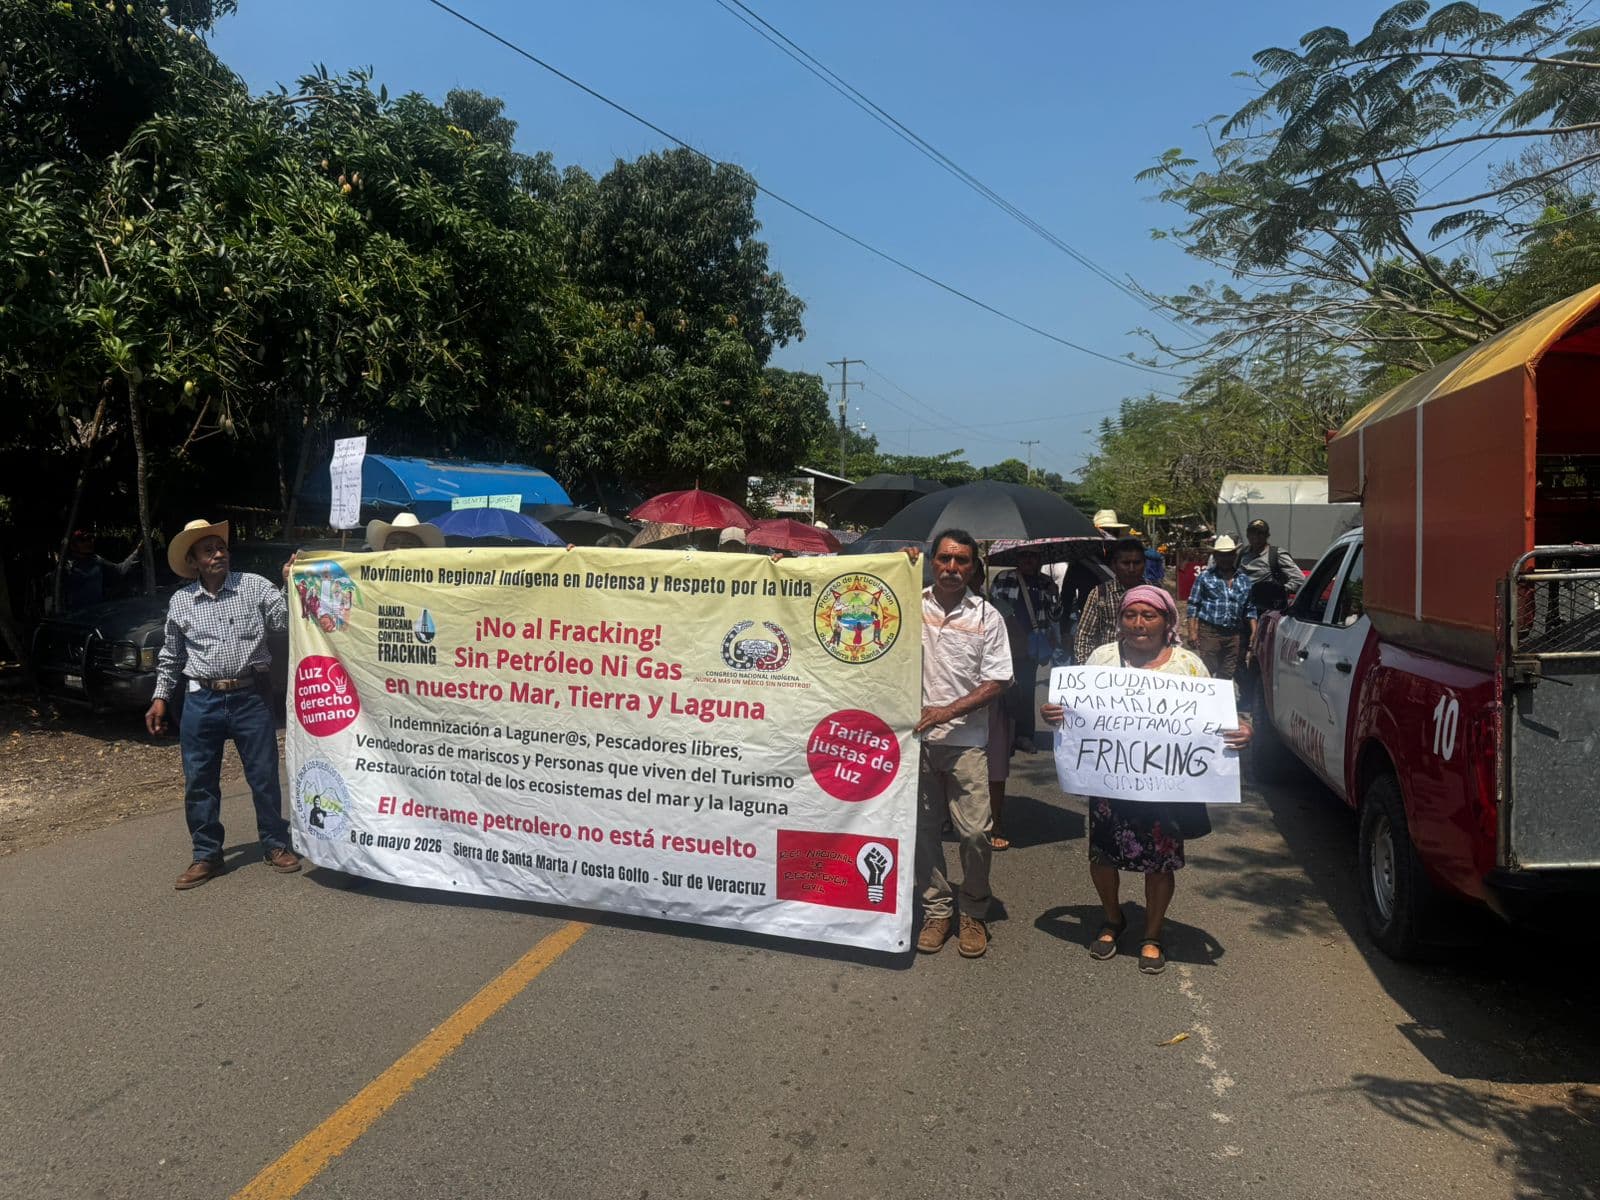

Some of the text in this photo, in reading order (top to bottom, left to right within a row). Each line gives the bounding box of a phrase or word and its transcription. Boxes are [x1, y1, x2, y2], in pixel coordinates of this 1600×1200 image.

[360, 565, 812, 598] Movimiento Regional Indígena en Defensa y Respeto por la Vida
[842, 576, 852, 584] de
[378, 604, 406, 618] ALIANZA
[378, 618, 412, 631] MEXICANA
[476, 616, 662, 650] ¡No al Fracking!
[378, 630, 414, 644] CONTRA EL
[378, 644, 436, 665] FRACKING
[454, 646, 682, 681] Sin Petróleo Ni Gas
[298, 666, 322, 681] Luz
[706, 670, 738, 678] CONGRESO
[738, 672, 768, 680] NACIONAL
[1057, 671, 1216, 696] LOS CIUDADANOS
[298, 682, 330, 697] como
[385, 676, 765, 724] en nuestro Mar, Tierra y Laguna
[1125, 688, 1146, 696] DE
[300, 693, 352, 711] derecho
[1058, 695, 1198, 716] AMAMALOYA
[302, 707, 356, 725] humano
[1062, 715, 1224, 737] NO ACEPTAMOS EL
[1433, 694, 1460, 760] 10
[389, 715, 743, 762] Indemnización a Laguner@s, Pescadores libres,
[828, 720, 890, 751] Tarifas
[356, 734, 795, 790] Vendedoras de mariscos y Personas que viven del Turismo
[809, 736, 894, 774] justas de
[1076, 738, 1216, 777] FRACKING
[834, 762, 862, 784] luz
[356, 757, 789, 817] Restauración total de los ecosistemas del mar y la laguna
[378, 796, 397, 814] El
[402, 798, 479, 826] derrame
[483, 810, 572, 840] petrolero
[578, 824, 604, 842] no
[610, 828, 655, 849] está
[662, 833, 757, 859] resuelto
[350, 830, 357, 844] 8
[360, 831, 374, 847] de
[377, 836, 411, 852] mayo
[414, 836, 442, 853] 2026
[453, 842, 482, 862] Sierra
[486, 847, 500, 863] de
[502, 850, 533, 868] Santa
[536, 854, 568, 873] Marta
[571, 858, 578, 874] /
[582, 860, 614, 880] Costa
[618, 864, 650, 884] Golfo
[662, 871, 685, 888] Sur
[687, 872, 703, 890] de
[707, 875, 766, 896] Veracruz
[780, 850, 853, 864] RED NACIONAL
